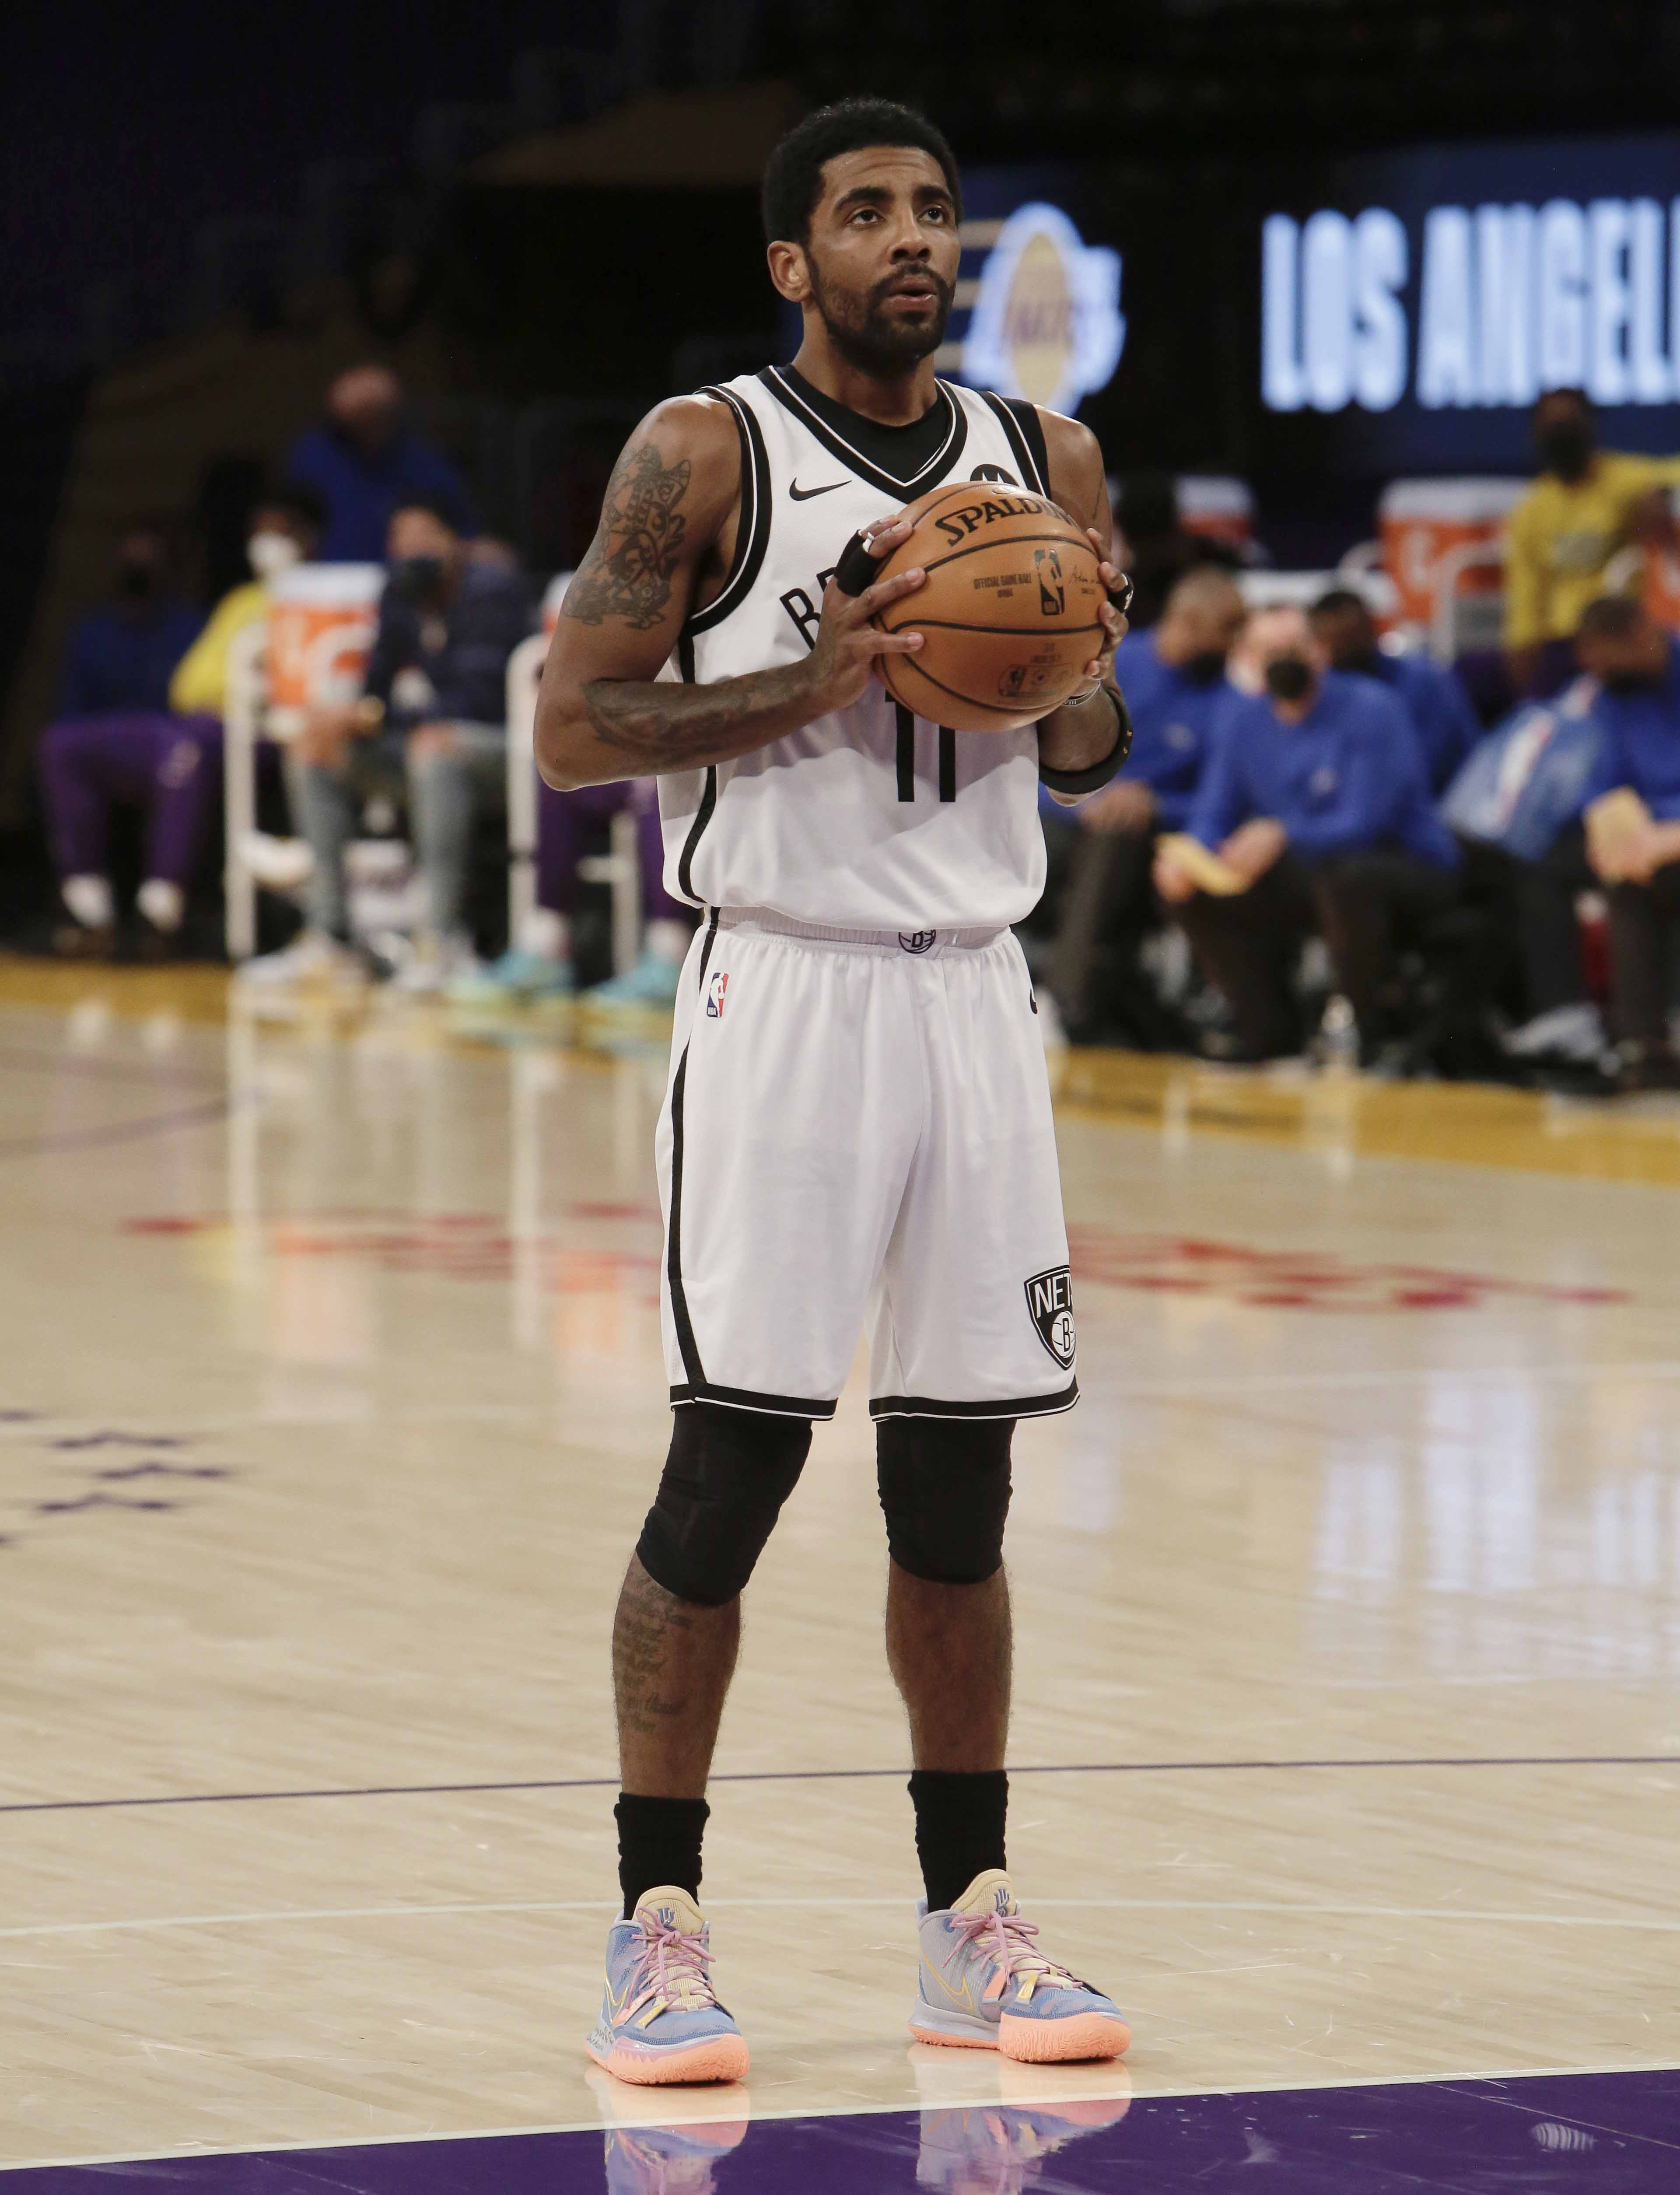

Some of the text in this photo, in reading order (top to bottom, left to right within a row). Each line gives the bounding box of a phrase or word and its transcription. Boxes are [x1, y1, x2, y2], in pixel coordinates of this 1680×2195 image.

[1262, 196, 1680, 412] LOS ANGEL
[885, 689, 956, 803] 11
[1034, 1273, 1073, 1318] NET
[1062, 1318, 1071, 1352] B
